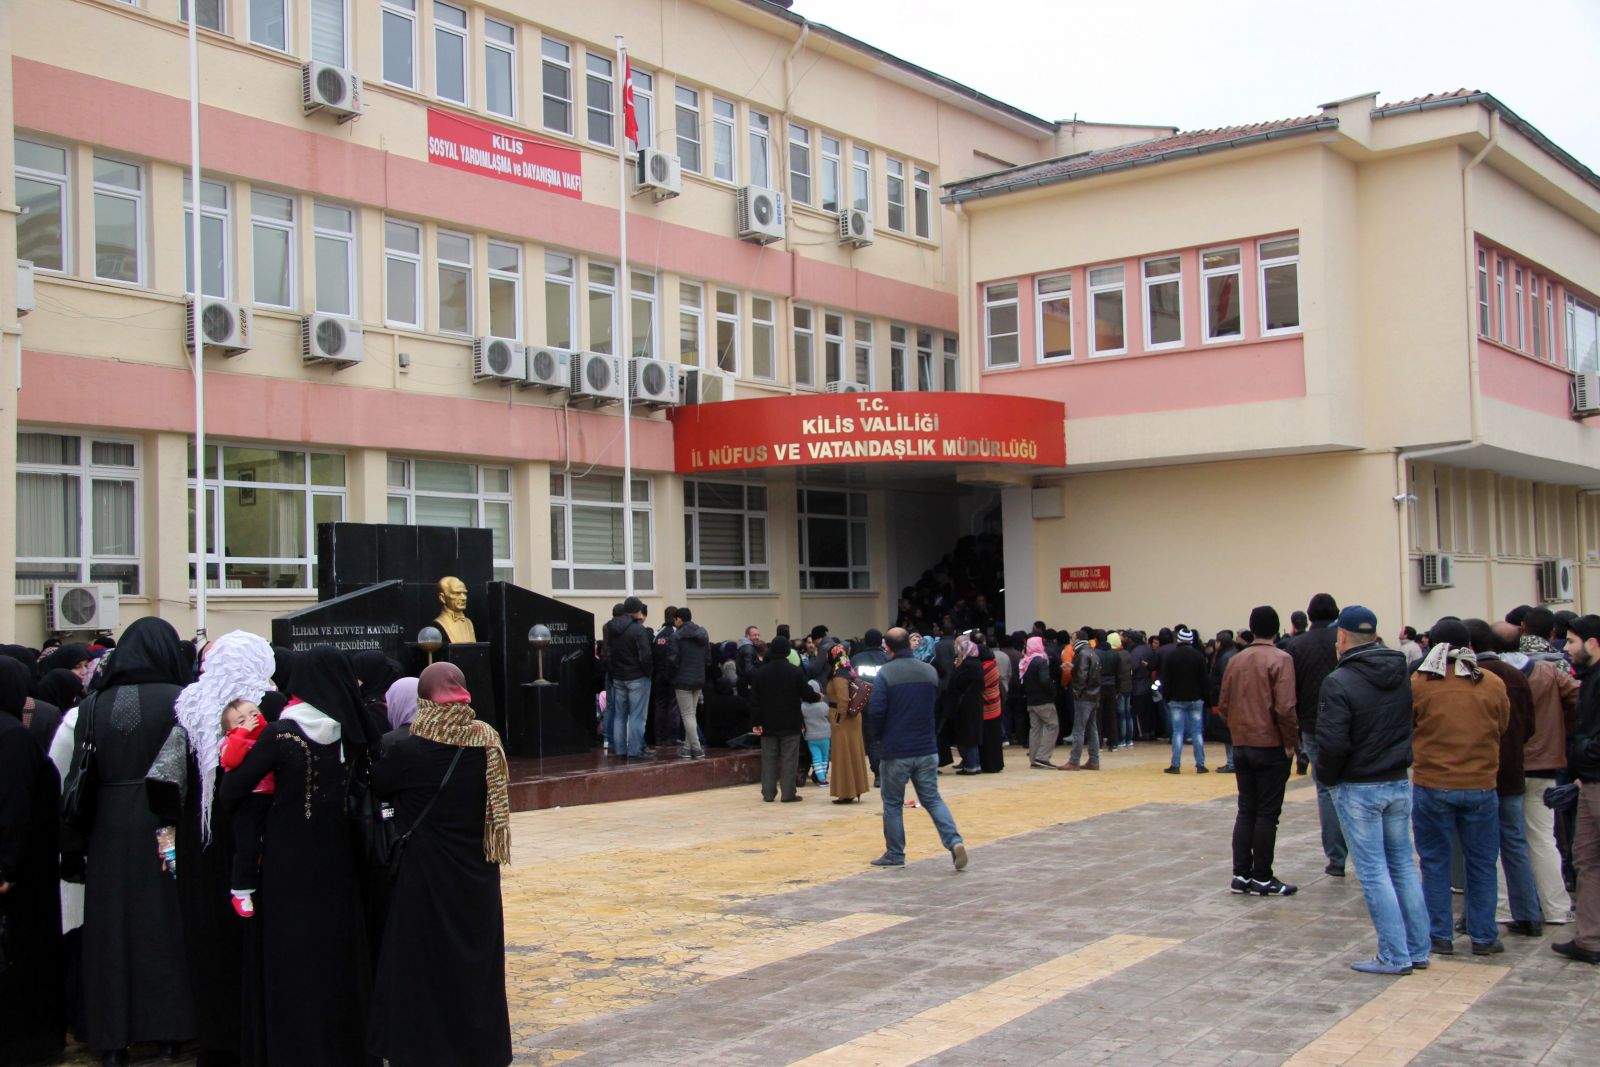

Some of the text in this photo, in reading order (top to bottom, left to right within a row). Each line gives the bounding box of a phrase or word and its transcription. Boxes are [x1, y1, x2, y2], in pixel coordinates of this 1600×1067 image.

[492, 133, 524, 156] KİLİS
[429, 136, 582, 192] SOSYAL YARDIMLAŞMA ve DAYANIŞMA VAKFI
[857, 398, 889, 412] T.C.
[802, 412, 939, 435] KİLİS VALİLİĞİ
[691, 437, 1037, 468] İL NÜFUS VE VATANDAŞLIK MÜDÜRLÜĞÜ
[292, 624, 319, 636] İLHAM
[320, 626, 332, 635] VE
[333, 626, 365, 635] KUVVET
